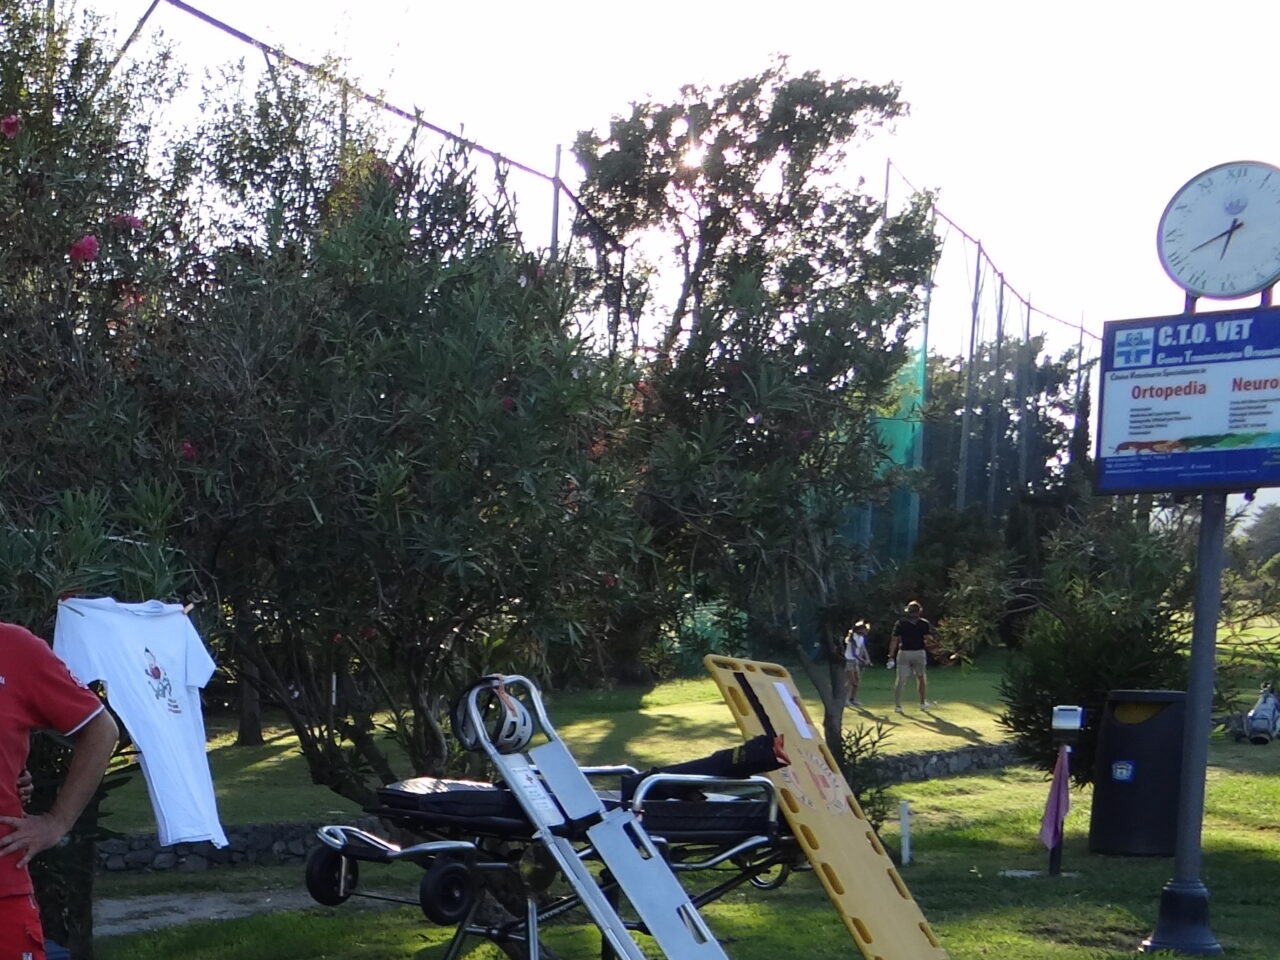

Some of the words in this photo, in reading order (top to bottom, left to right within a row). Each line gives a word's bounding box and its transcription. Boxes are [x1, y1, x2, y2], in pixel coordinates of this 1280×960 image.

[1158, 323, 1211, 347] C.T.O.
[1215, 318, 1254, 342] VET
[1132, 380, 1207, 401] Ortopedia
